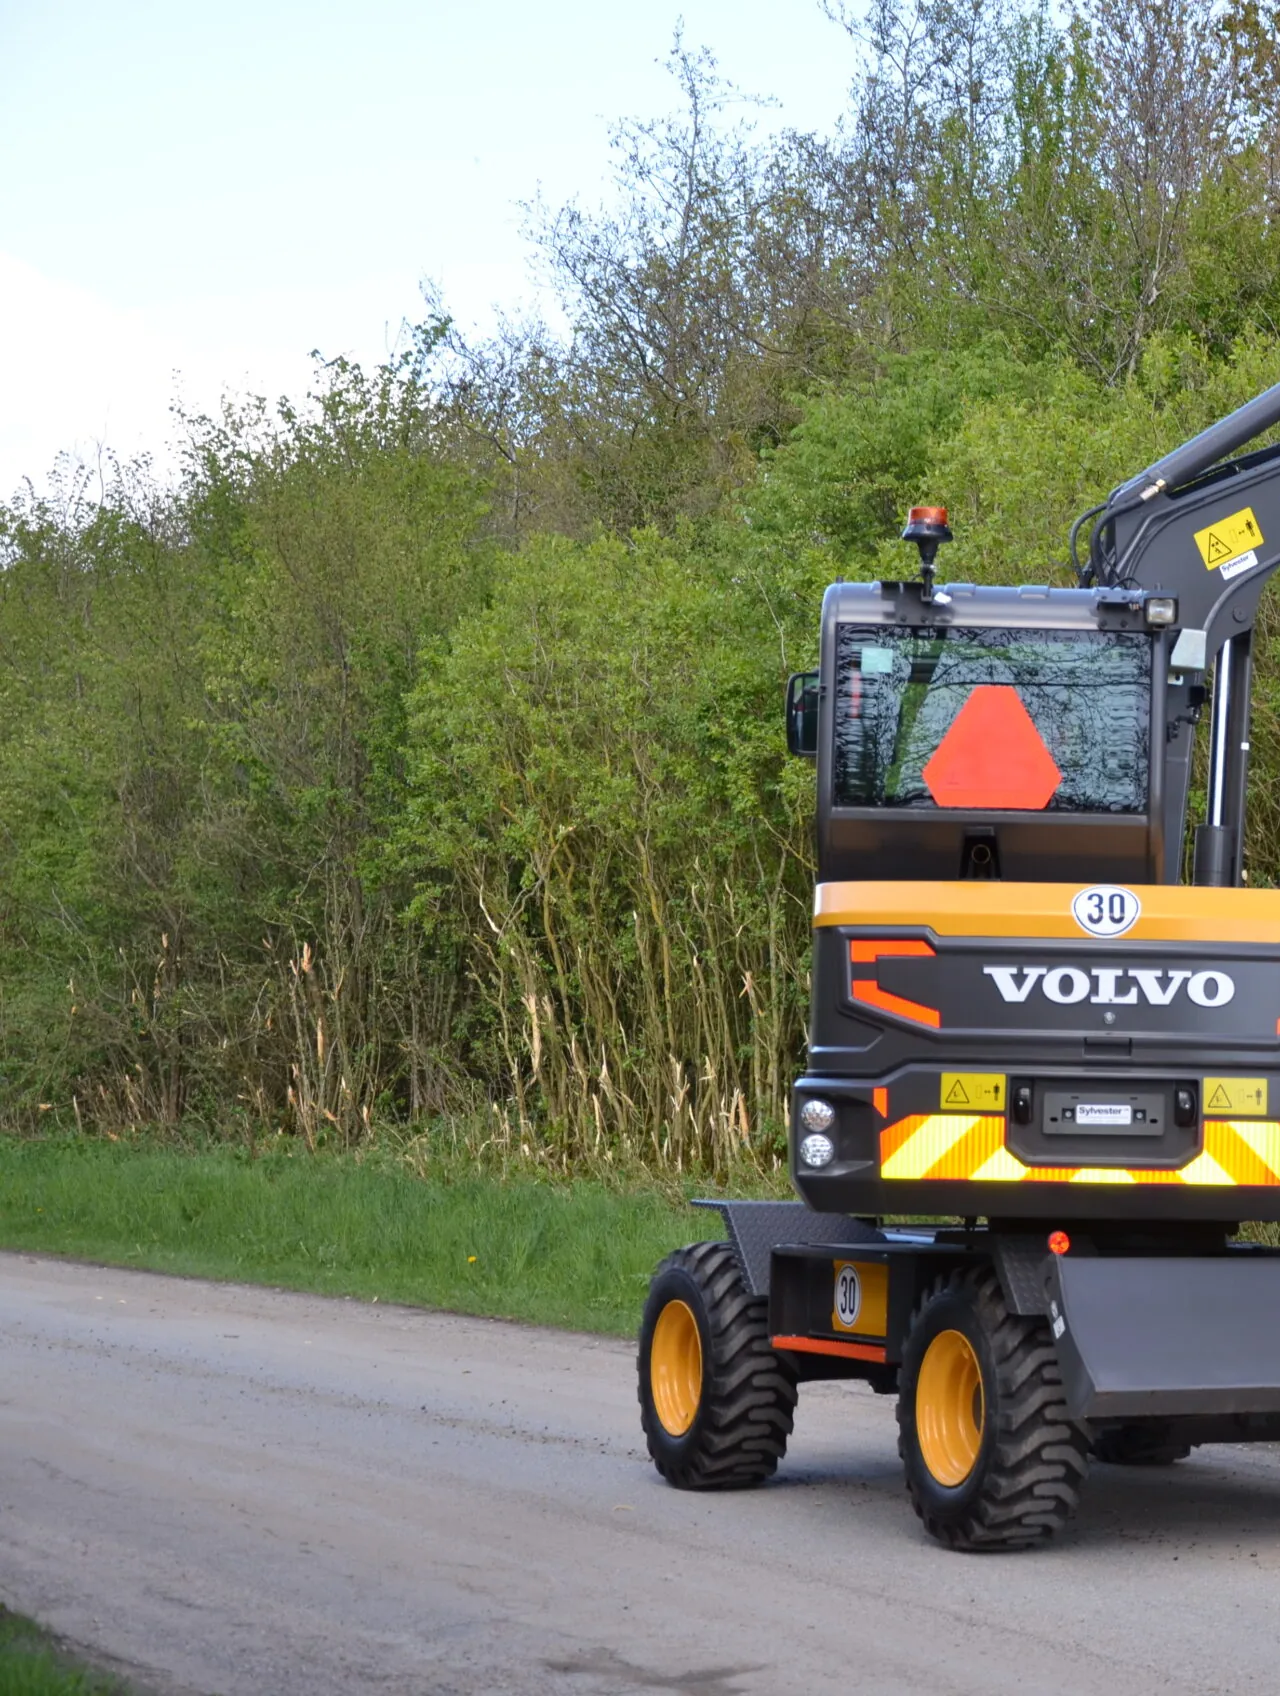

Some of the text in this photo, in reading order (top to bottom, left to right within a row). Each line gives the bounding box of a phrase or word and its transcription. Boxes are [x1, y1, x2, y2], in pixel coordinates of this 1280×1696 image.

[1087, 893, 1126, 925] 30
[983, 964, 1235, 1007] VOLVO
[1079, 1106, 1123, 1116] Sylvester
[840, 1276, 856, 1315] 30
